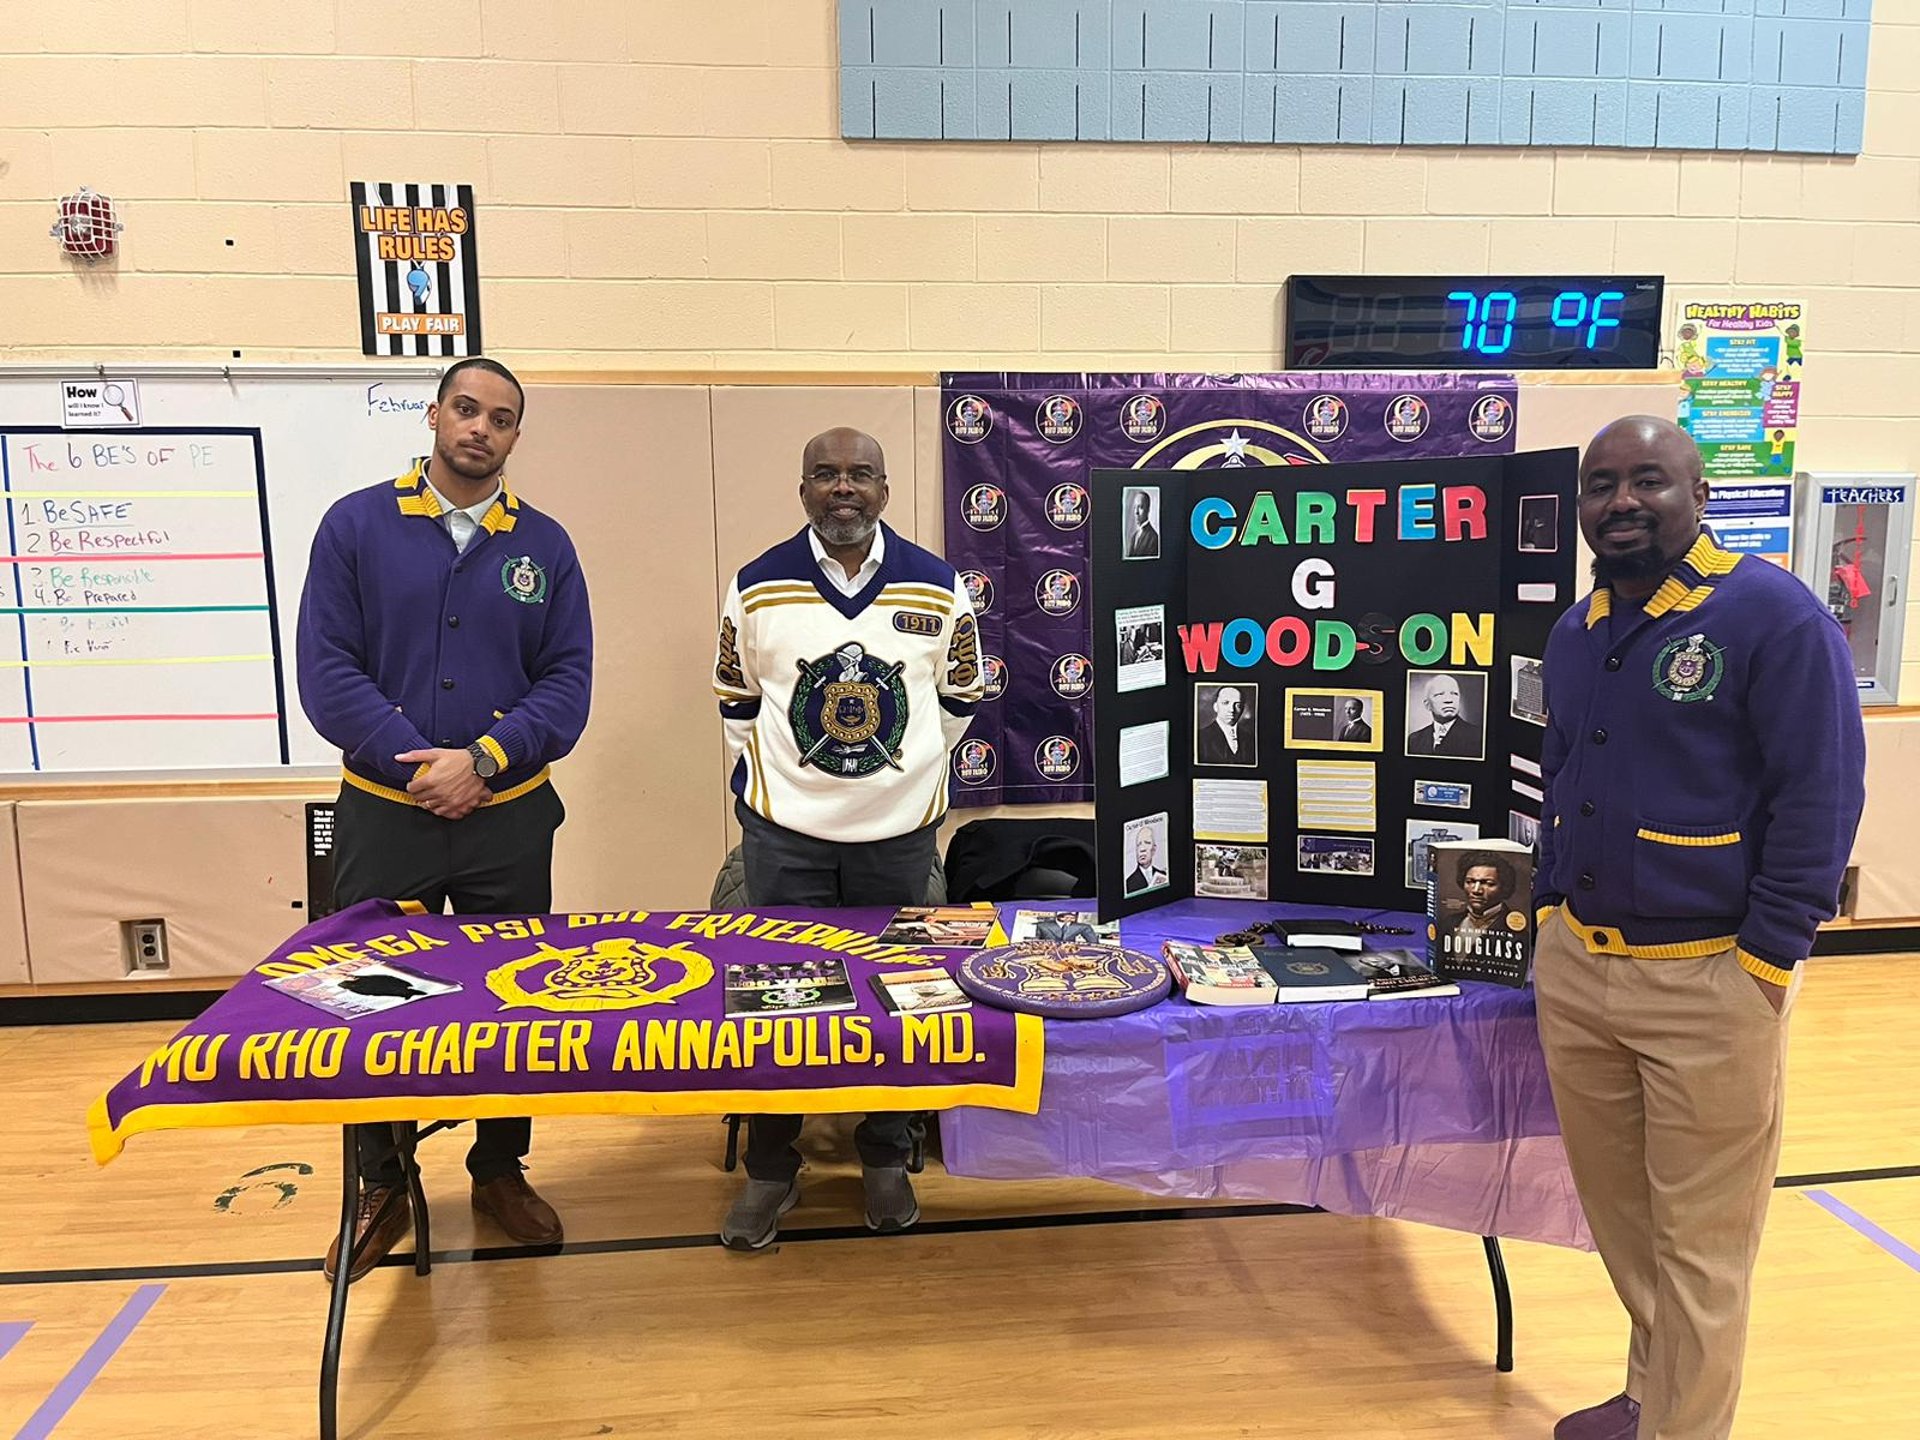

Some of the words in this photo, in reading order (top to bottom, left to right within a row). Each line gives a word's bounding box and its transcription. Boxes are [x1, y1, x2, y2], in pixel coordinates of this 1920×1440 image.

[360, 206, 412, 233] LIFE
[415, 207, 468, 233] HAS
[378, 235, 456, 261] RULES
[382, 316, 422, 332] PLAY
[425, 317, 460, 333] FAIR
[1448, 292, 1517, 354] 70
[1685, 303, 1747, 320] HEALTHY
[66, 386, 97, 398] How
[22, 442, 59, 473] The
[67, 442, 82, 468] 6
[189, 443, 215, 468] PE
[1826, 487, 1901, 503] TEACHERS
[1190, 483, 1488, 550] CARTER
[50, 530, 73, 552] Be
[50, 567, 76, 588] Be
[1292, 558, 1335, 610] G
[84, 590, 137, 606] Prepared
[902, 615, 938, 633] 1911
[1177, 612, 1494, 673] WOODSON
[255, 929, 449, 979] OMEGA
[458, 917, 546, 943] PSI
[1444, 935, 1523, 961] DOUGLASS
[139, 1033, 230, 1089] MU
[239, 1027, 350, 1080] RHO
[365, 1019, 593, 1075] CHAPTER
[612, 1014, 885, 1072] ANNAPOLIS,
[901, 1012, 986, 1064] MD.
